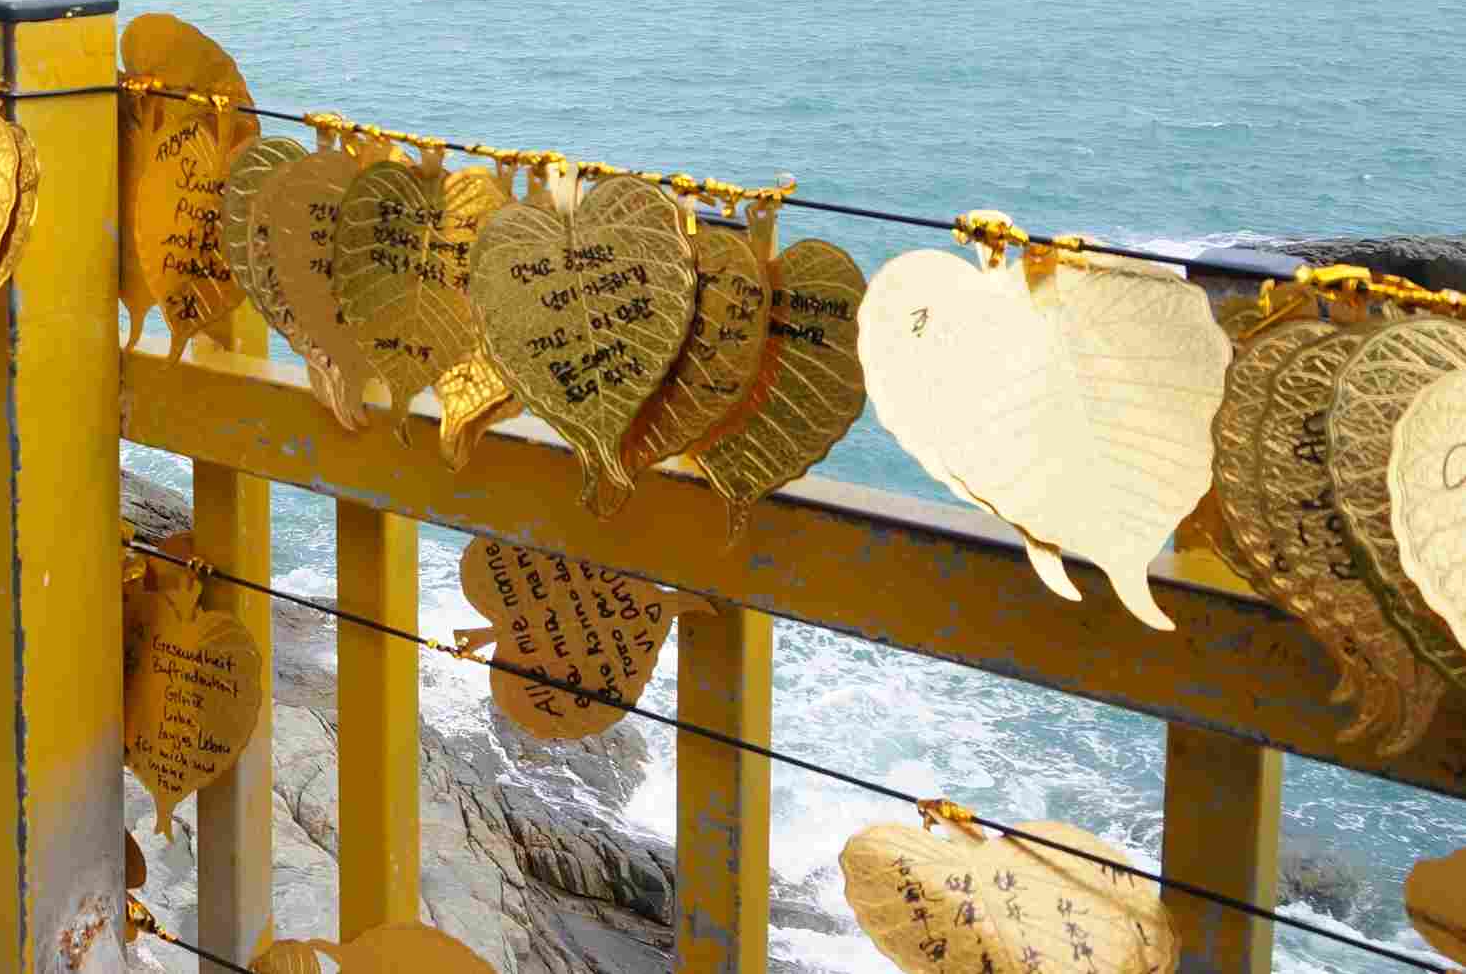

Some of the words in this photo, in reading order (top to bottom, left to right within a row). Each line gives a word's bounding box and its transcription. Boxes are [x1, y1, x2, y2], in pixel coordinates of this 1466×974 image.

[486, 543, 518, 607] nonne
[512, 615, 537, 655] mie
[569, 589, 604, 657] hanno
[152, 635, 236, 671] Gesundheit
